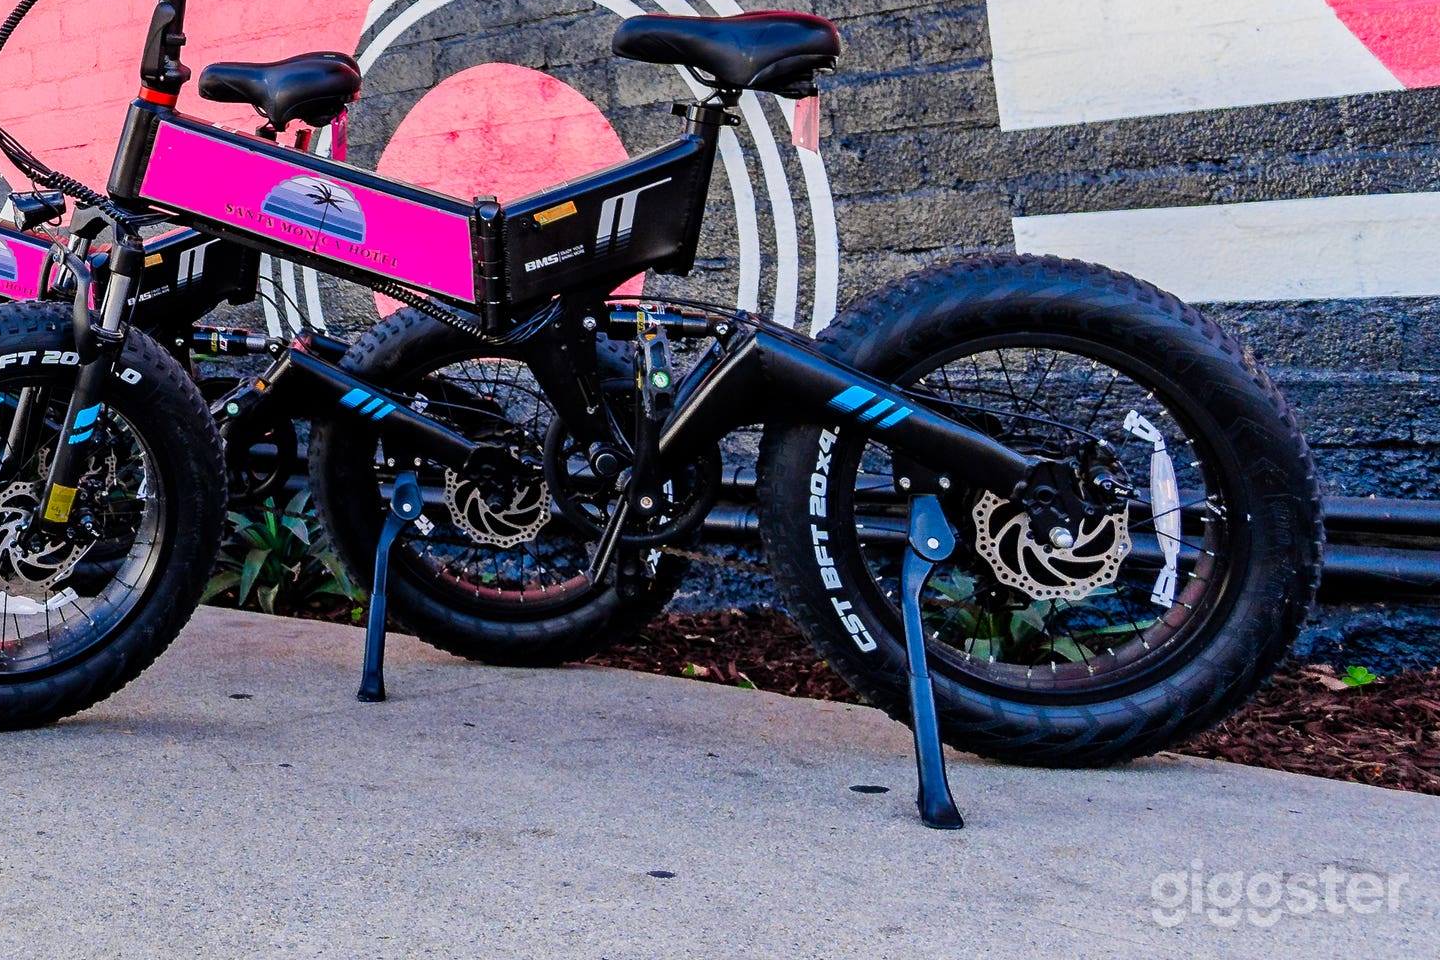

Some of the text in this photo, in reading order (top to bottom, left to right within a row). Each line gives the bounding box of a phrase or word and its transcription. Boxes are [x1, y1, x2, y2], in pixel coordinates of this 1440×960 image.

[224, 203, 274, 229] SANTA
[348, 244, 398, 268] HOTEL
[524, 252, 559, 273] BMS
[810, 523, 843, 590] BFT
[830, 596, 878, 653] CST
